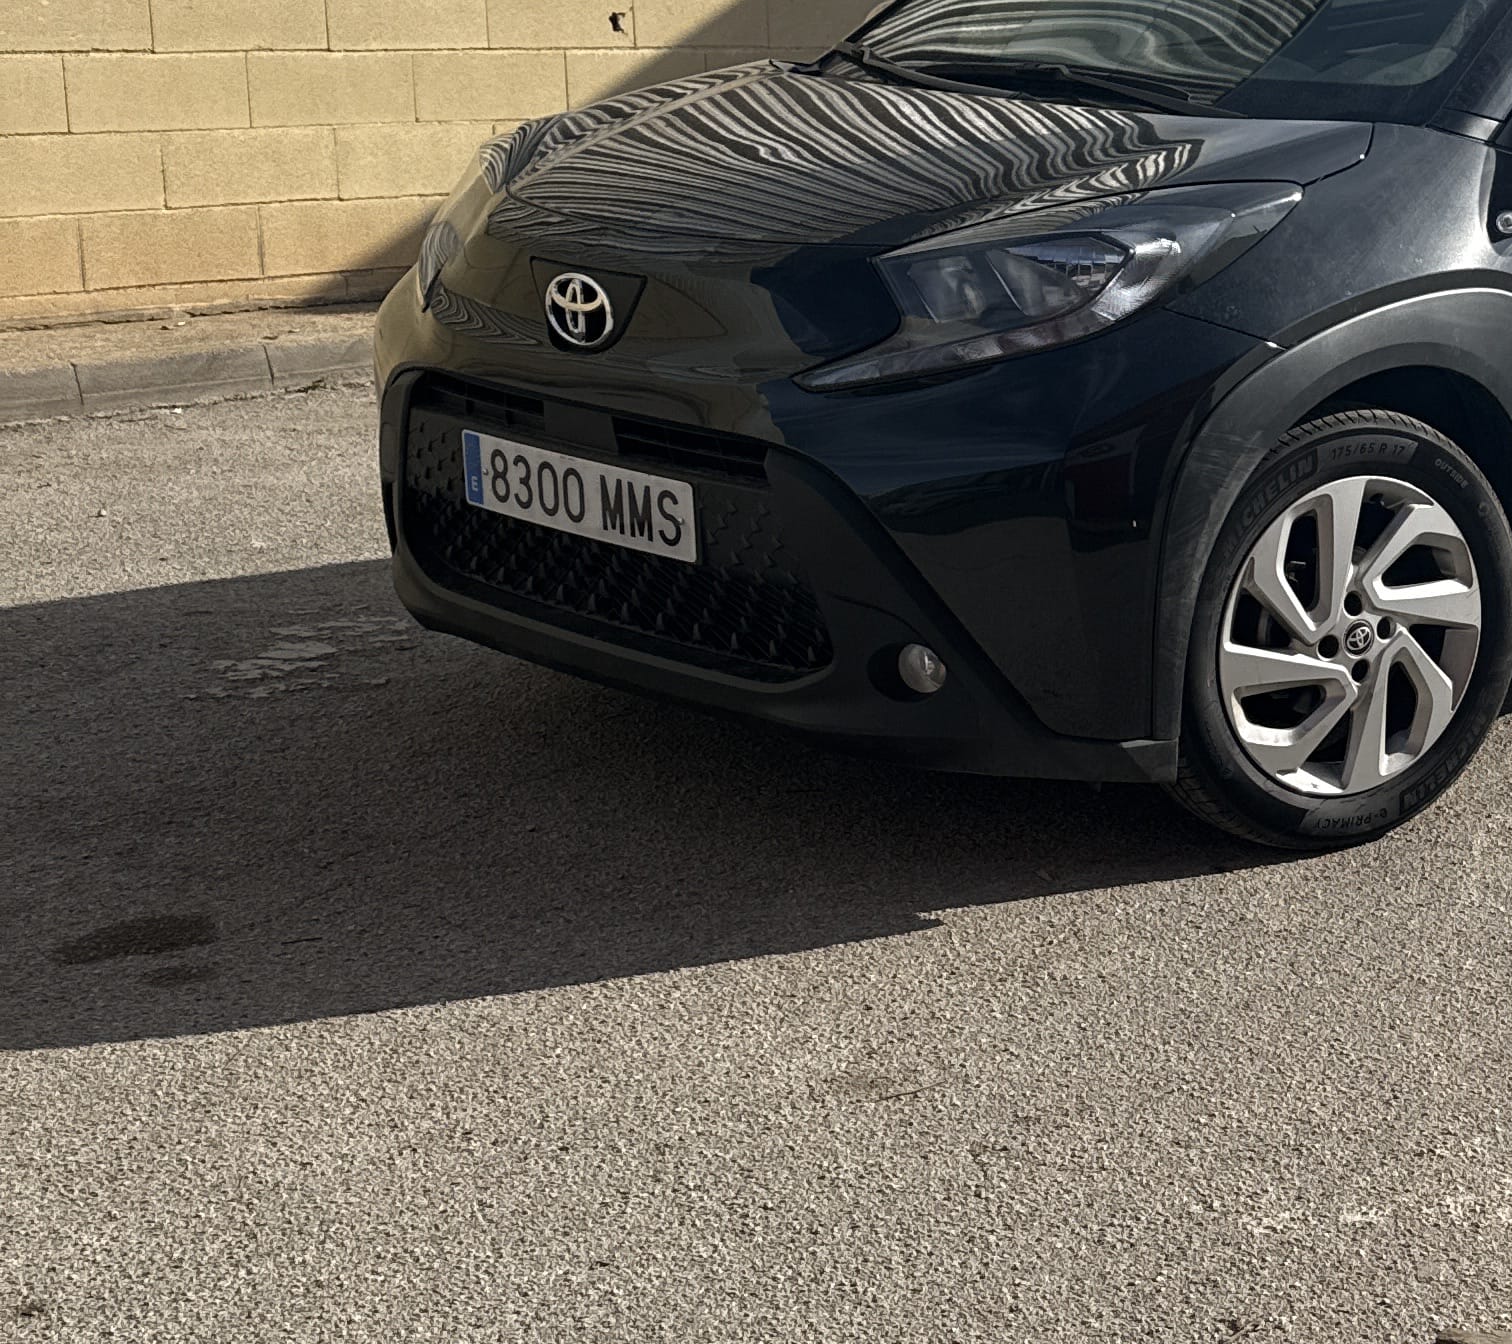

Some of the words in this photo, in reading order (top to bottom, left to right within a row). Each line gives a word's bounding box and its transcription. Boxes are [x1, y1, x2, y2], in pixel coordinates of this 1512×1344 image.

[1331, 442, 1375, 460] 175/65
[1378, 441, 1387, 454] R
[1391, 442, 1405, 455] 17
[471, 475, 479, 492] E
[1434, 458, 1469, 489] OUTSIDE
[490, 449, 585, 523] 8300
[600, 474, 682, 546] MMS
[1220, 454, 1315, 560] MICHELIN
